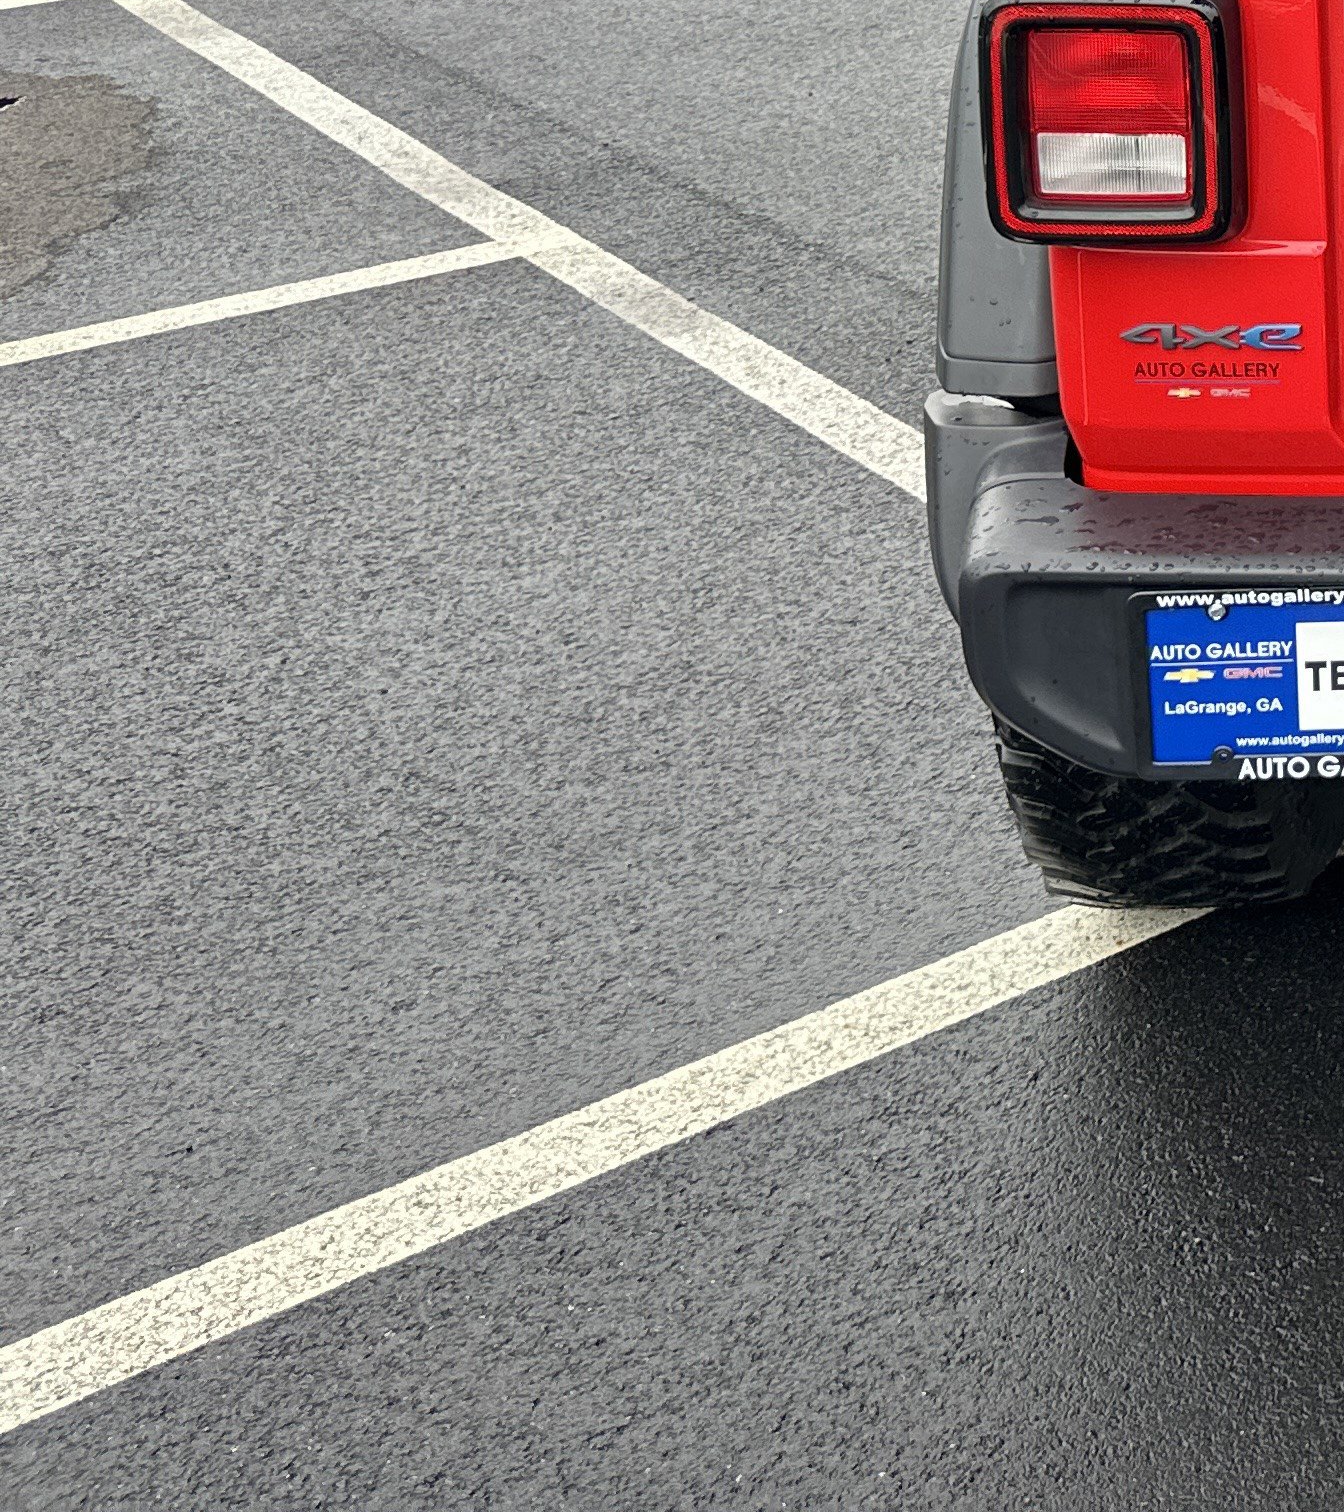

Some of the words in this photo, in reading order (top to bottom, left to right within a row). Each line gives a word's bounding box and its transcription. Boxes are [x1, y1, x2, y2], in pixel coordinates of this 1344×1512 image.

[1134, 362, 1185, 377] AUTO
[1191, 362, 1280, 377] GALLERY
[1150, 643, 1201, 661] AUTO
[1205, 641, 1293, 659] GALLERY
[1223, 666, 1283, 679] GMC
[1164, 699, 1252, 717] LaGrange,
[1256, 697, 1283, 713] GA
[1238, 754, 1310, 780] AUTO
